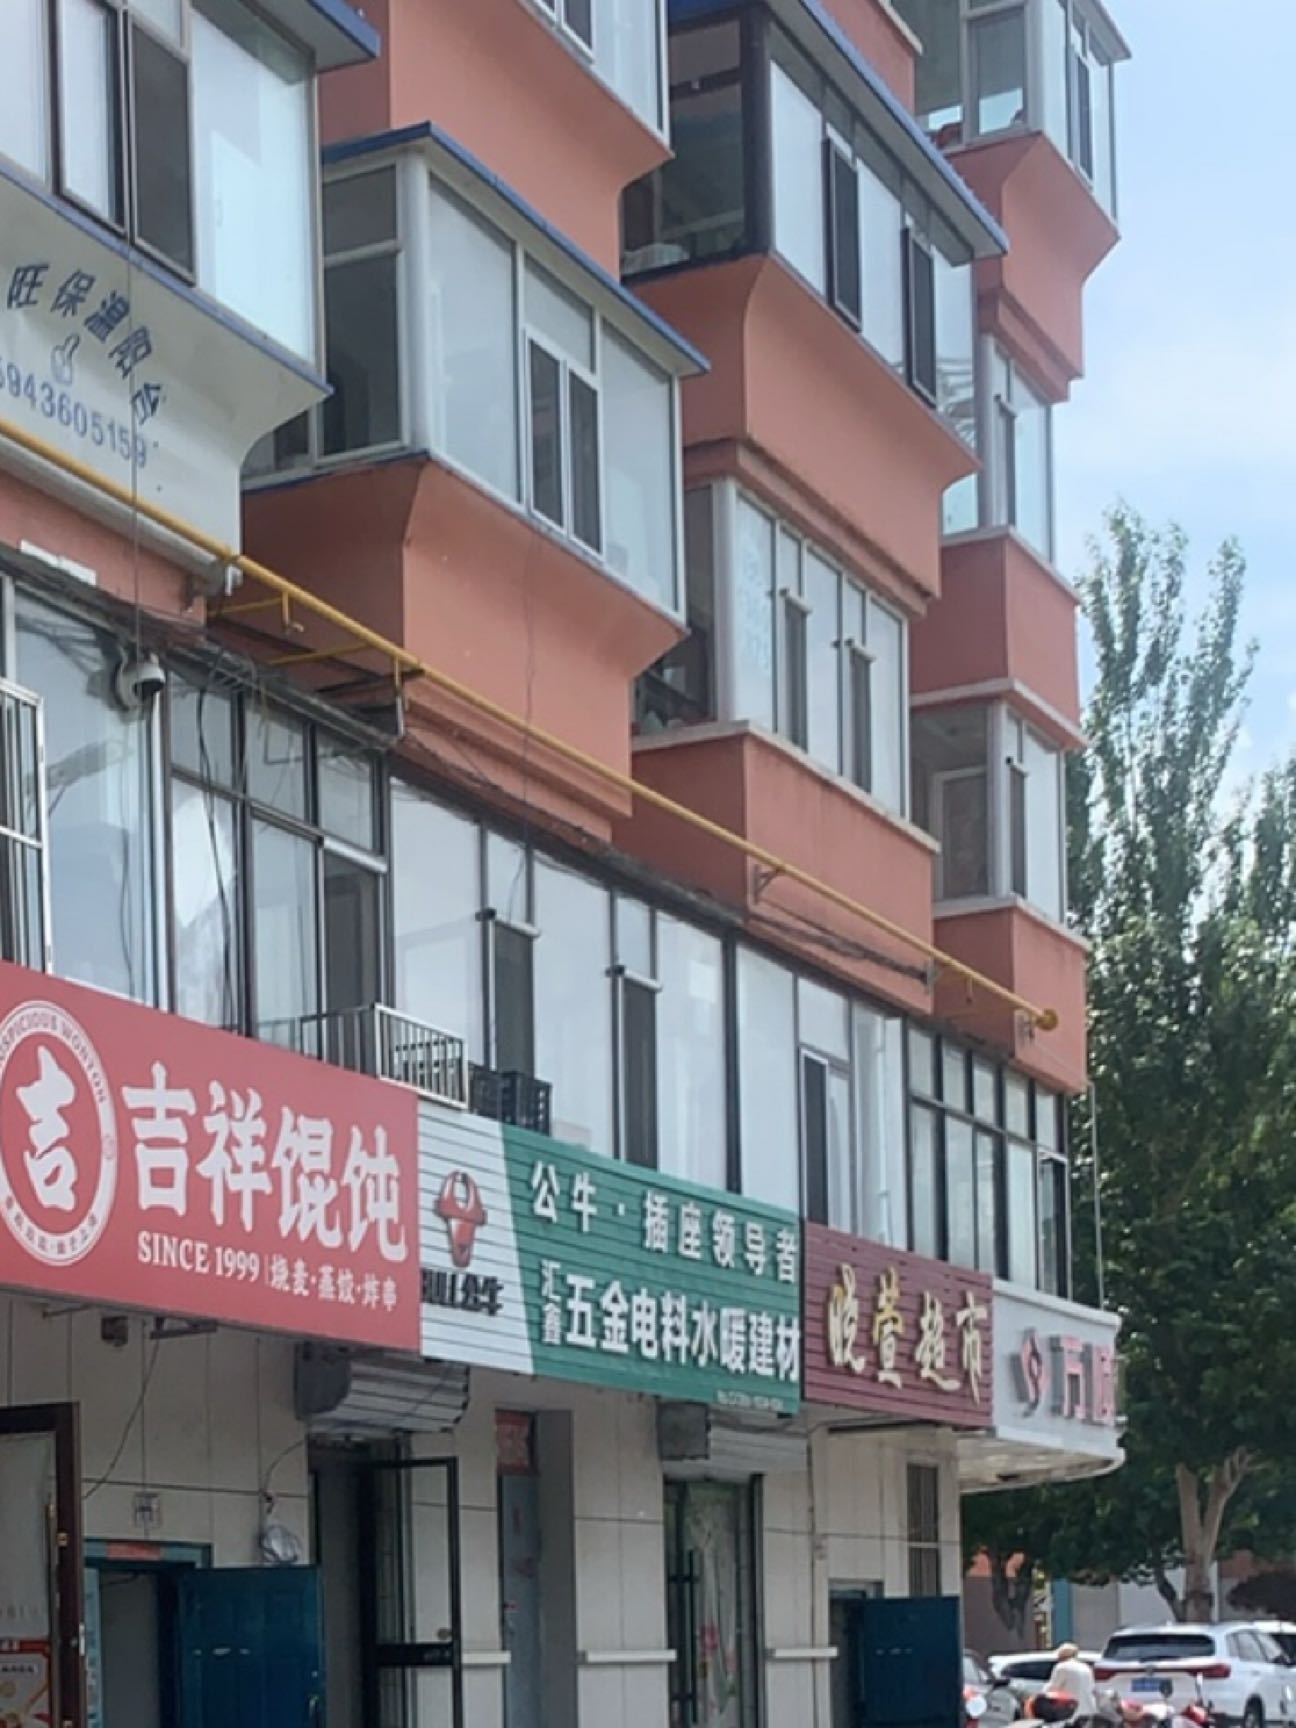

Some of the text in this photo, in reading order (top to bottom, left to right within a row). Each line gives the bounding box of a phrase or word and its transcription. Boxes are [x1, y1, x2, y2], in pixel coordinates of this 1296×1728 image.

[121, 1061, 409, 1262] 吉祥馄饨
[138, 1231, 260, 1282] SINCE 1999
[566, 1273, 800, 1382] 五金电料水暖建材
